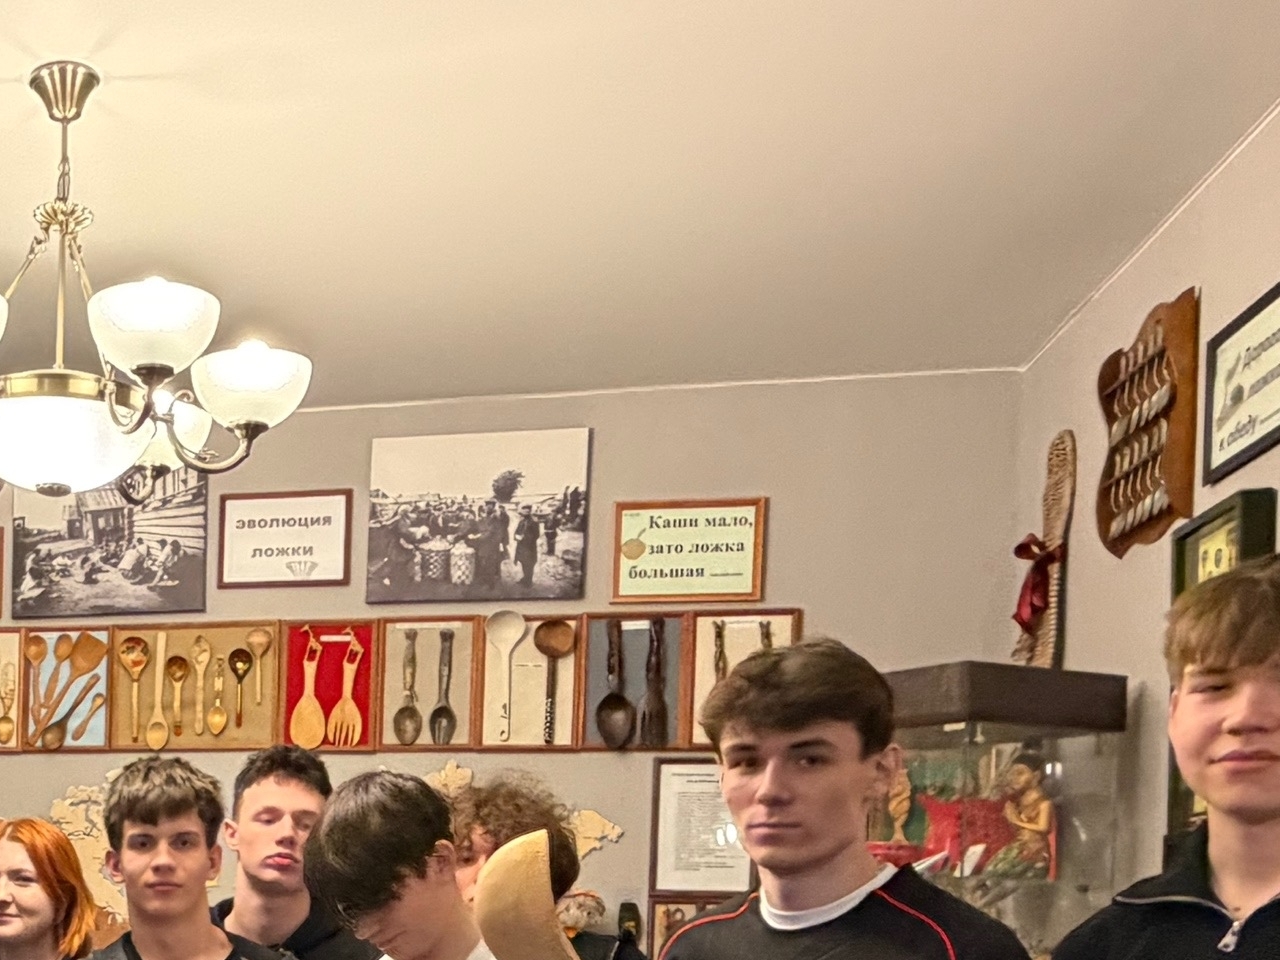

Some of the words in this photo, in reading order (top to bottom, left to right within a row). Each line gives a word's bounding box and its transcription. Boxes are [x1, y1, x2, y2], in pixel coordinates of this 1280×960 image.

[648, 515, 698, 529] Каши
[704, 515, 753, 528] мало,
[648, 543, 683, 555] зато
[688, 542, 745, 553] ложка
[628, 565, 705, 580] большая
